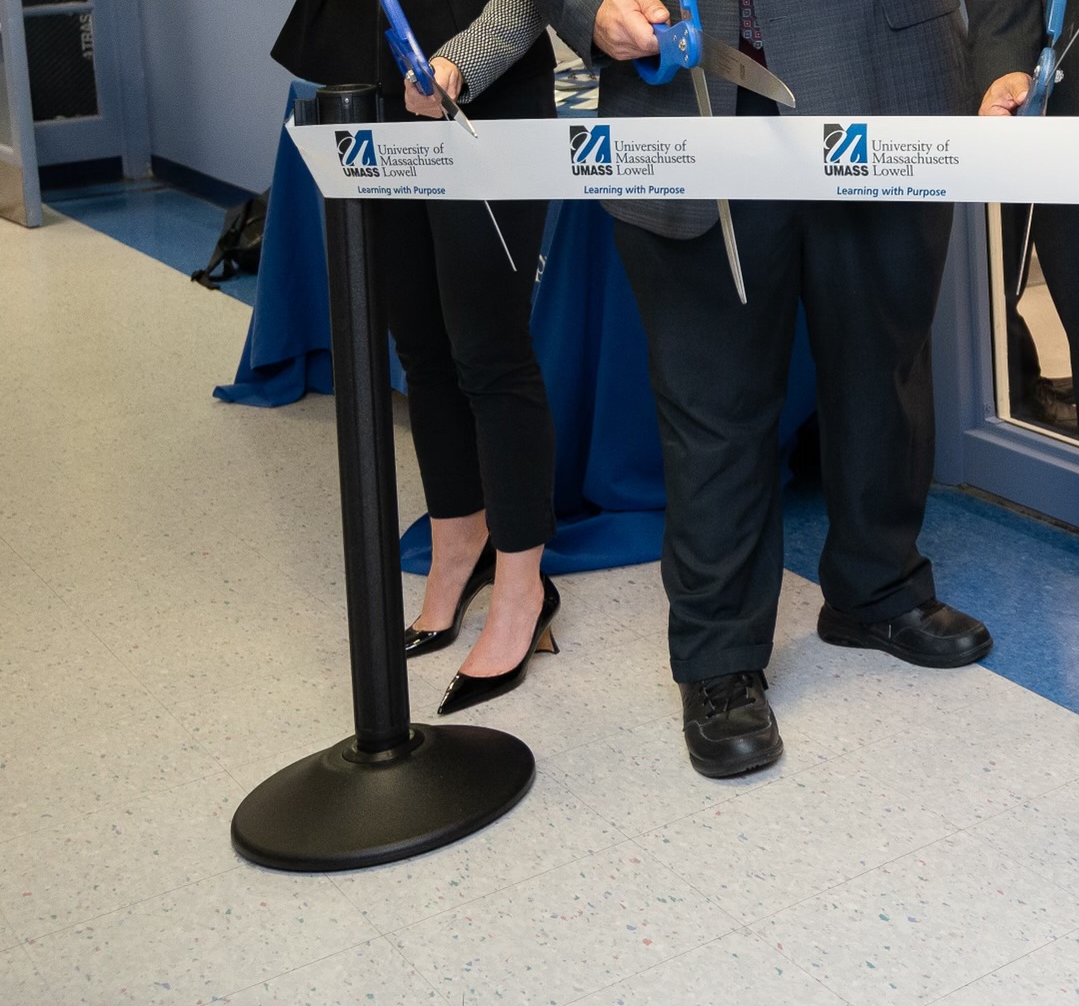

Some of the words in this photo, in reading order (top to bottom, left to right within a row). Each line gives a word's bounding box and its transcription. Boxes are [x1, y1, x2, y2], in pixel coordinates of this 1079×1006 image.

[377, 144, 430, 157] University
[433, 142, 445, 154] of
[614, 140, 671, 154] University
[674, 139, 687, 152] of
[872, 140, 933, 154] University
[936, 139, 950, 152] of
[380, 155, 454, 167] Massachusetts
[615, 152, 696, 164] Massachusetts
[872, 152, 959, 165] Massachusetts
[343, 167, 380, 178] UMASS
[382, 166, 417, 177] Lowell
[572, 165, 613, 176] UMASS
[616, 164, 655, 176] Lowell
[824, 165, 869, 176] UMASS
[873, 165, 914, 177] Lowell
[358, 186, 391, 196] Learning
[393, 186, 411, 194] with
[413, 186, 446, 196] Purpose
[584, 185, 623, 197] Learning
[625, 185, 646, 194] with
[648, 185, 685, 196] Purpose
[837, 186, 879, 198] Learning
[881, 186, 904, 196] with
[906, 187, 947, 198] Purpose
